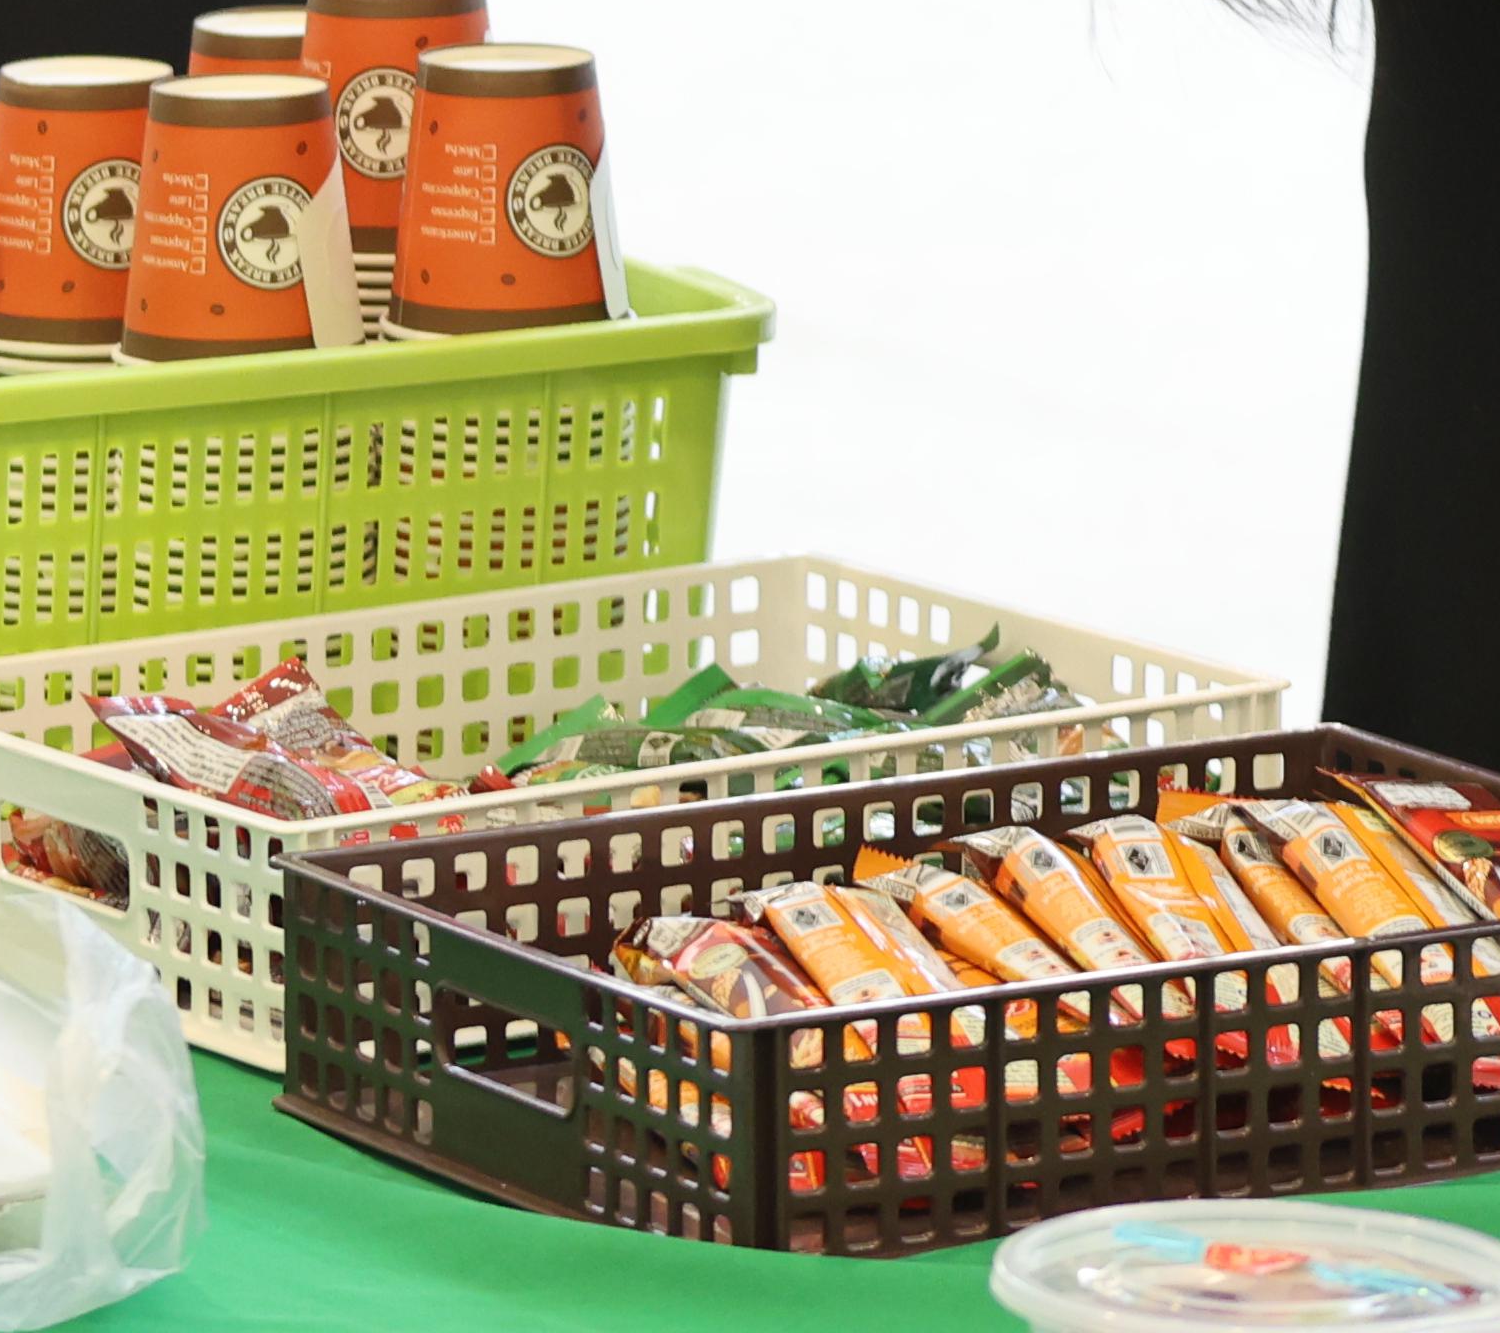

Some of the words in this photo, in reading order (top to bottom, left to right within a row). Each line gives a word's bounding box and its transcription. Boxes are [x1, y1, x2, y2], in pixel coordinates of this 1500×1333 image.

[445, 143, 480, 159] Mocha
[163, 173, 194, 188] Mocha
[226, 185, 265, 223] BREAK
[229, 249, 271, 283] BREAK
